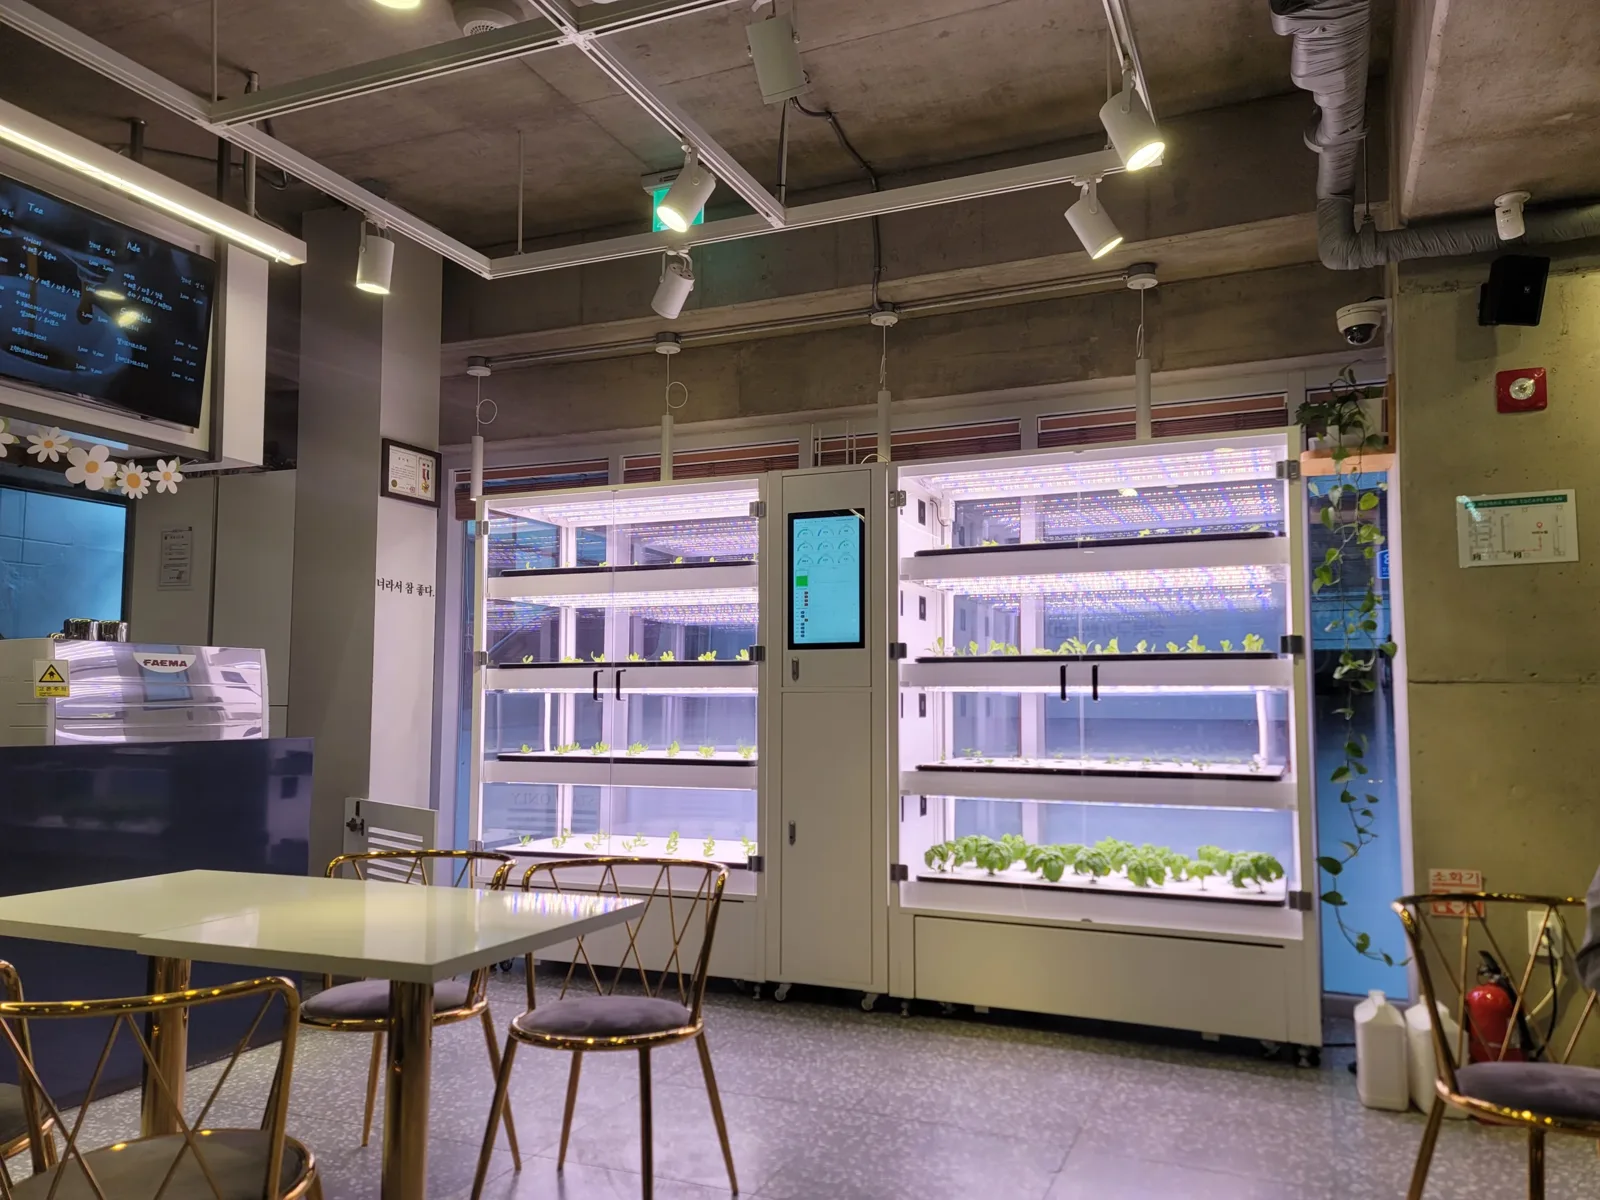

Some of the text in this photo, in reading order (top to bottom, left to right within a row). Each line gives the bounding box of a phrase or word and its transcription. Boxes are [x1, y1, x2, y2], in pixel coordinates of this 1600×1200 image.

[27, 202, 44, 216] Tea
[126, 241, 141, 253] Ade
[376, 577, 435, 598] 너라서 참 좋다.
[142, 658, 188, 668] FAEMA
[1432, 871, 1480, 885] 소화기
